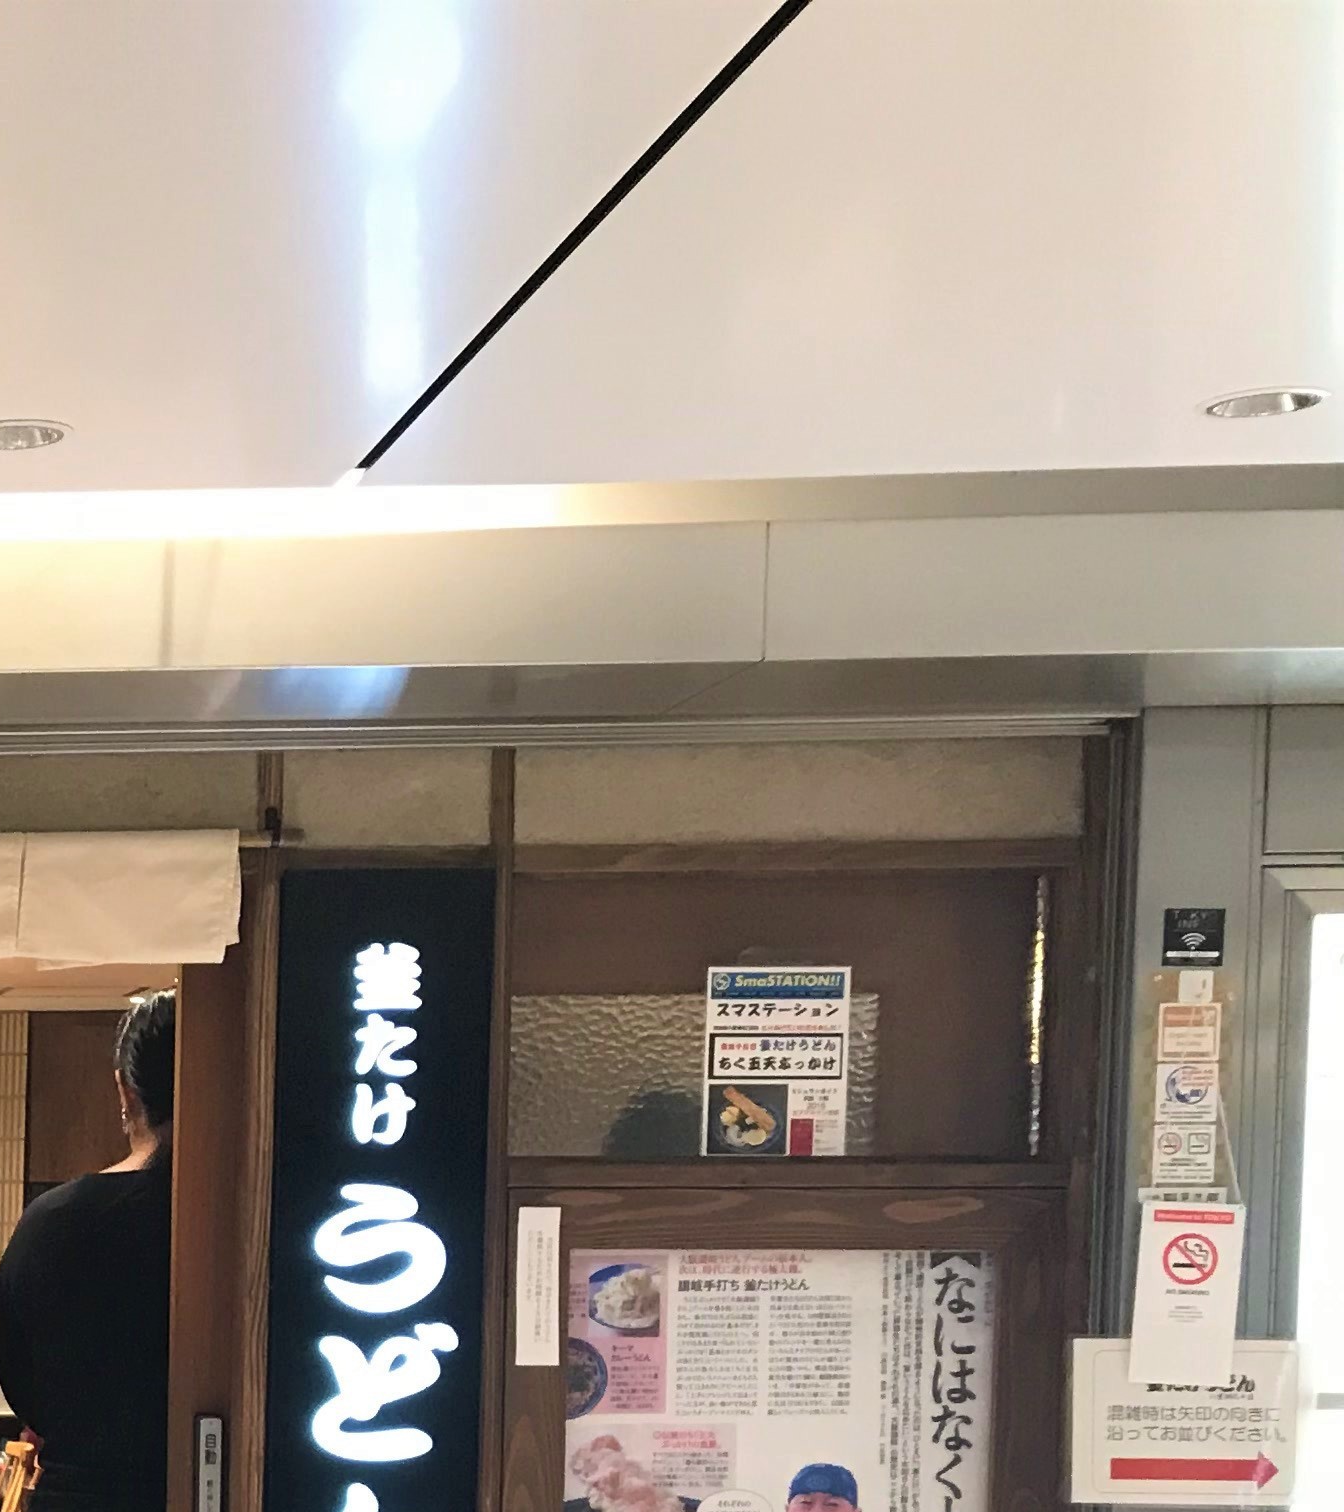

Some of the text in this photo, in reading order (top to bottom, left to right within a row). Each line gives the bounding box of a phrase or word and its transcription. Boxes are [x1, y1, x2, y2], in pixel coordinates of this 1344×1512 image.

[735, 974, 840, 987] SmaSTATION!!
[717, 1003, 839, 1017] スマステーション
[353, 942, 423, 1145] 釜たけ
[678, 1279, 810, 1292] 讃岐手打ち 釜たけうどん
[1107, 1405, 1281, 1422] 混雑時は矢印の向きに
[1107, 1425, 1288, 1442] 沿ってお並びください。
